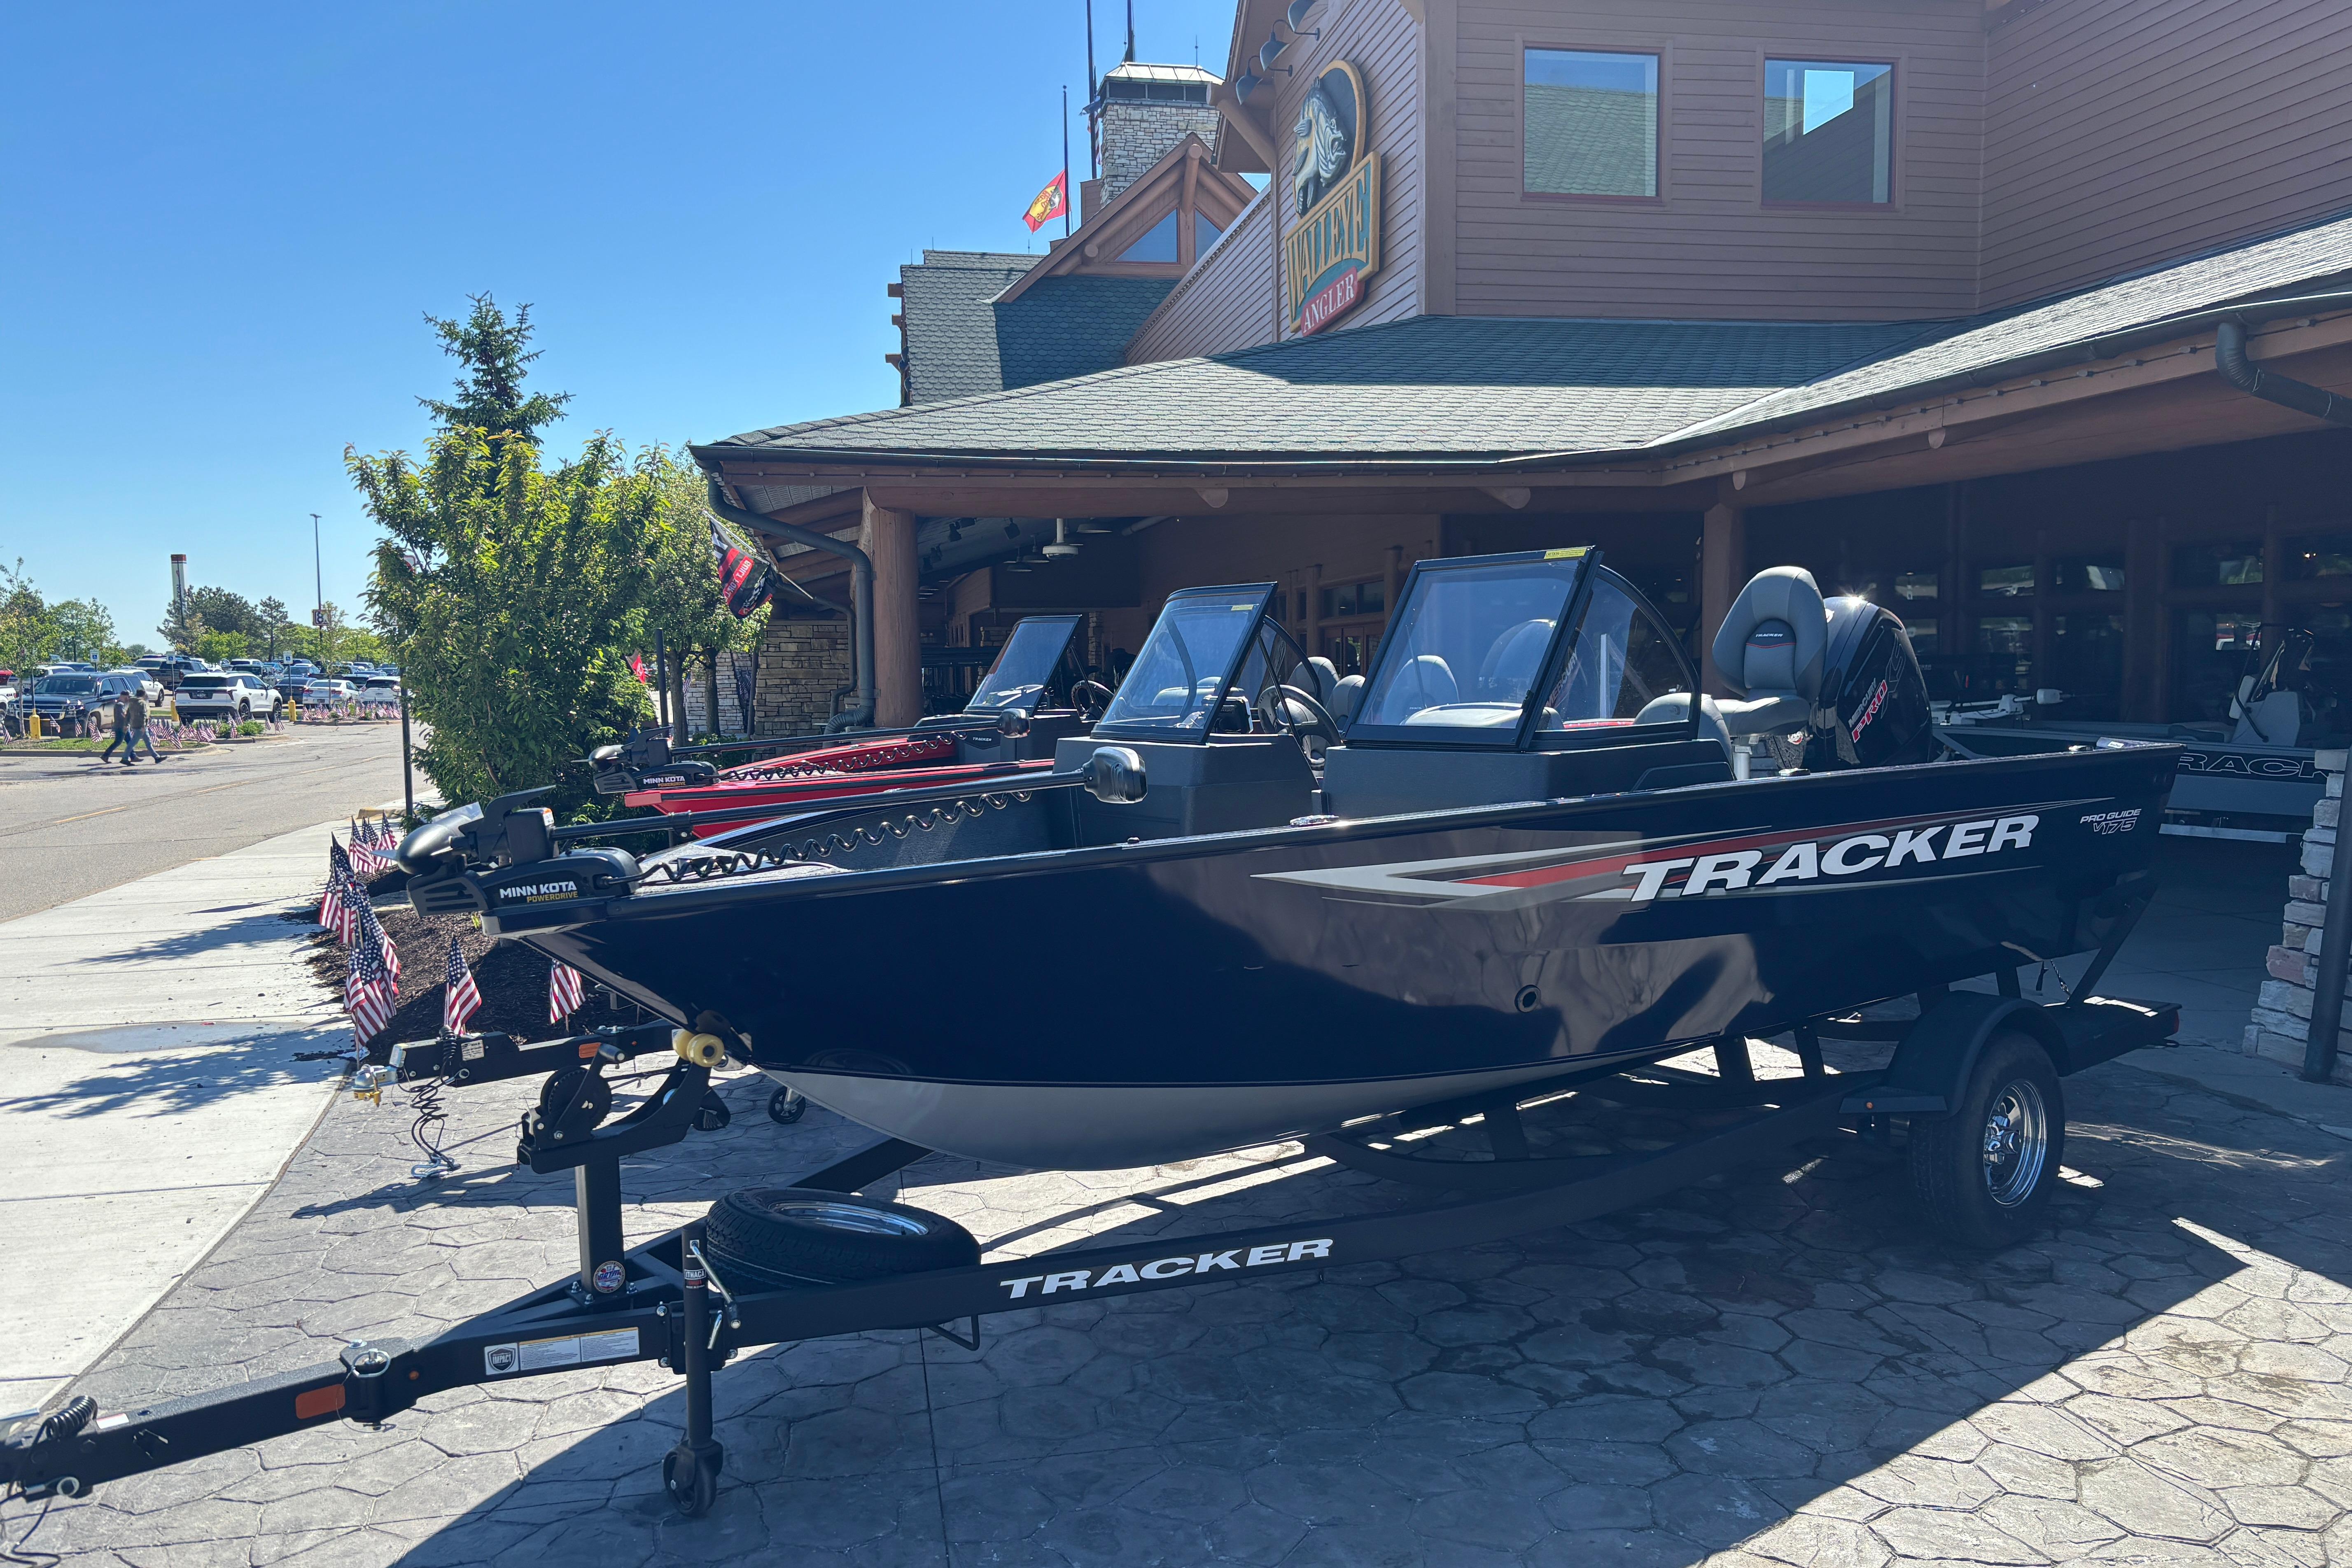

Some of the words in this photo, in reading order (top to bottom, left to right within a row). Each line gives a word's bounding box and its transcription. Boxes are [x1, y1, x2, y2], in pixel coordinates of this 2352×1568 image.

[1287, 169, 1367, 320] WALLEYE
[1303, 273, 1355, 333] ANGLER
[1848, 677, 1876, 728] MERCURY
[1851, 679, 1888, 743] PRO
[2080, 814, 2106, 824] PRO
[2106, 809, 2142, 820] GUIDE
[2093, 817, 2137, 835] V175
[1621, 815, 2040, 902] TRACKER
[499, 885, 537, 898] MINN
[540, 881, 577, 894] KOTA
[527, 891, 579, 903] POWERDRIVE
[686, 1270, 705, 1278] ITHACA
[1000, 1238, 1334, 1299] TRACKER
[492, 1354, 511, 1365] IMPACT
